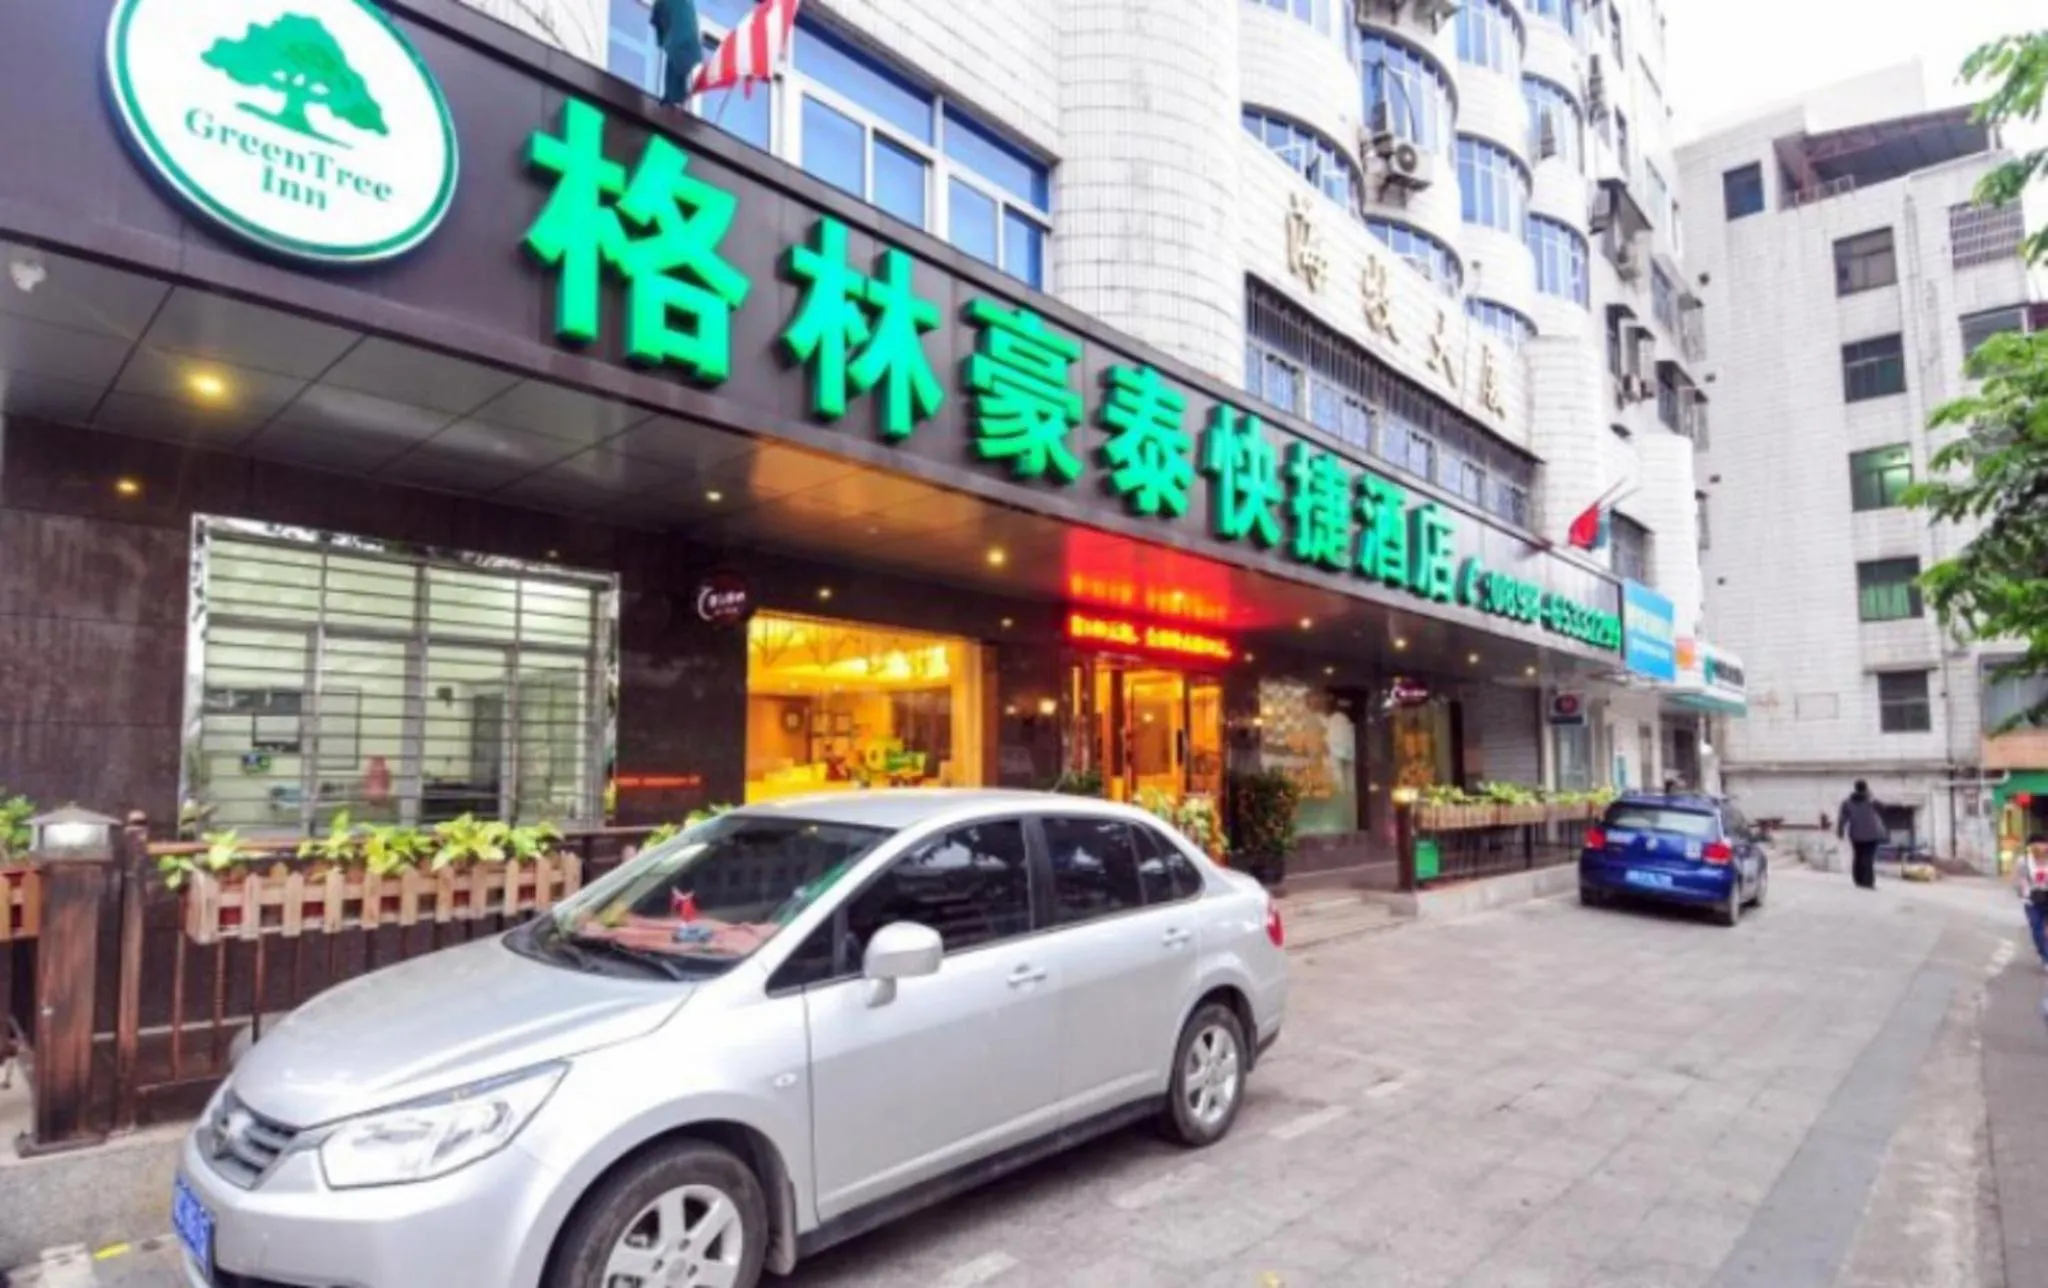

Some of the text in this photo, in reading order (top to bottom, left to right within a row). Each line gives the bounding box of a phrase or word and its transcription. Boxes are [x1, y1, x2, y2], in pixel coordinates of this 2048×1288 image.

[184, 106, 394, 203] GreenTree
[260, 163, 328, 212] Inn
[523, 95, 1456, 604] 格林豪泰快捷酒店
